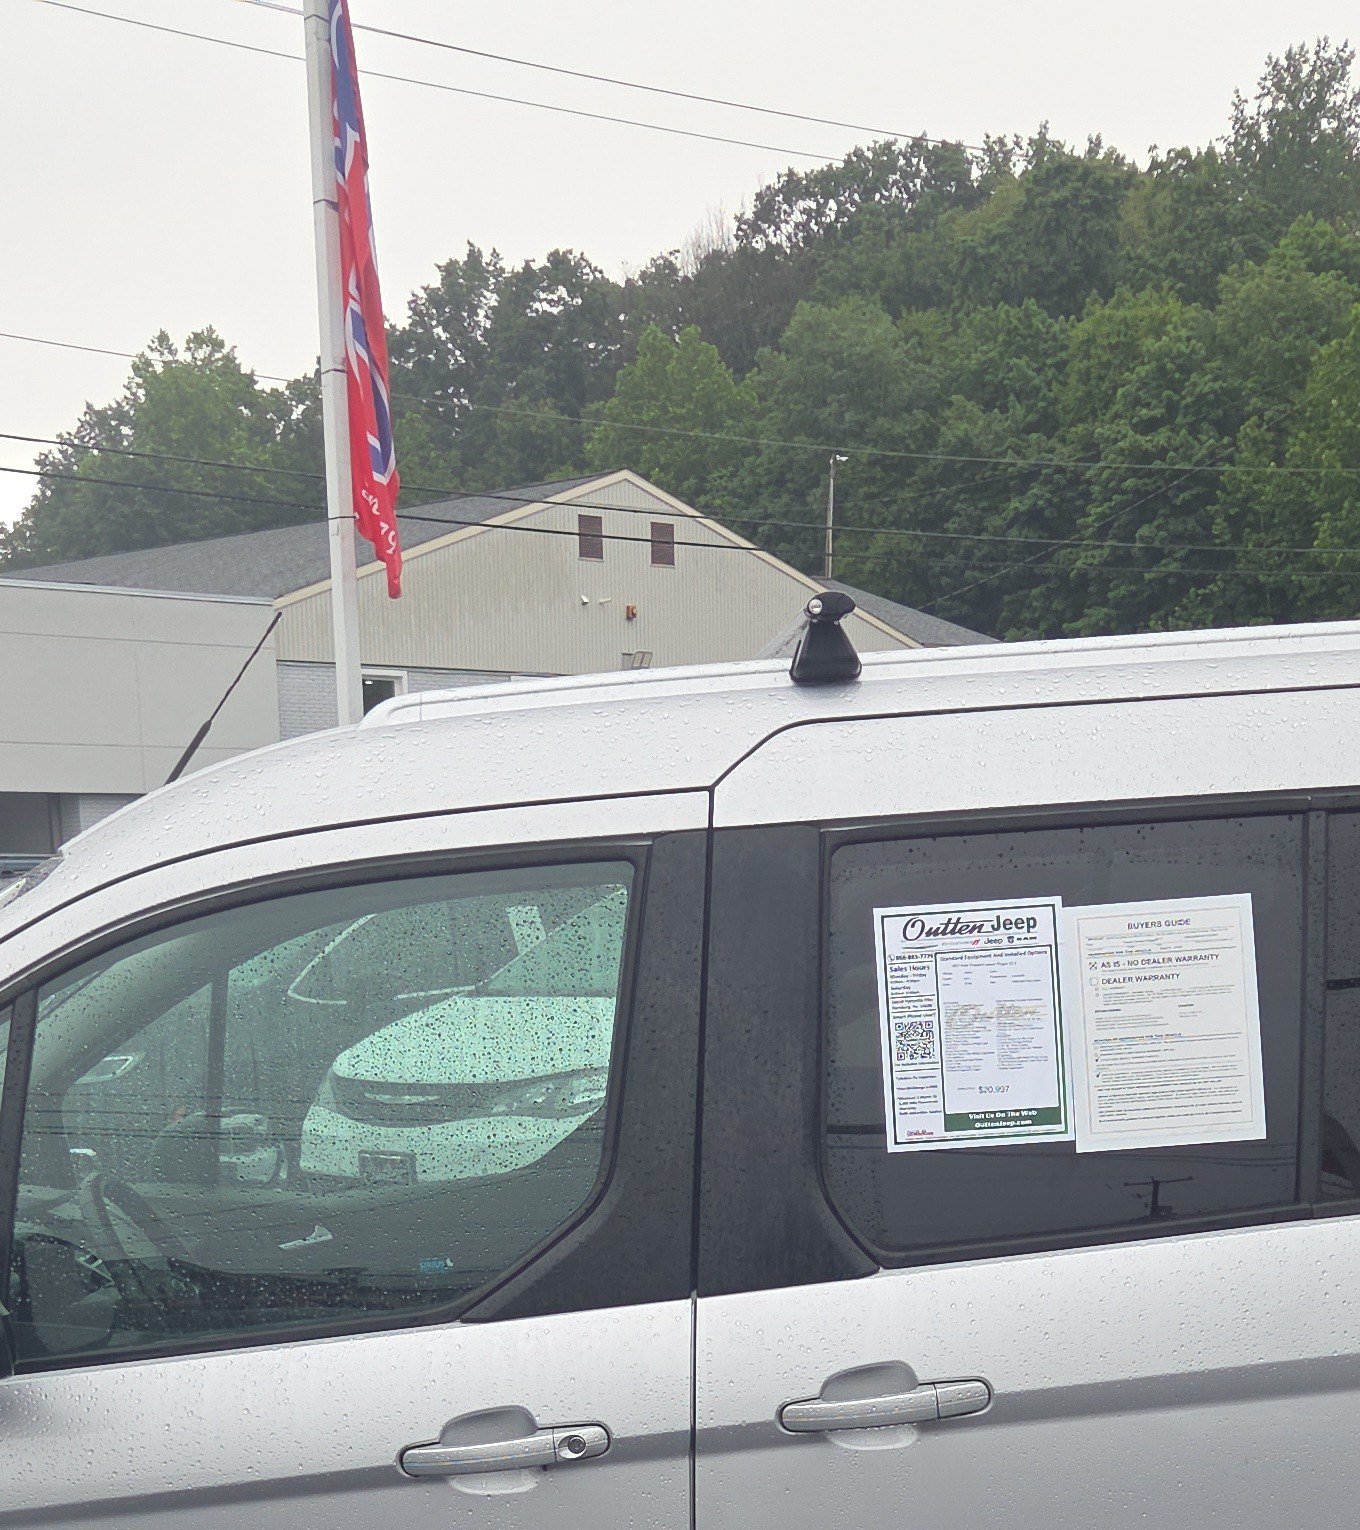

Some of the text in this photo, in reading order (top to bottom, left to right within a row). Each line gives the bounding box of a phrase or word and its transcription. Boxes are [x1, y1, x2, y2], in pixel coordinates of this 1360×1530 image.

[902, 914, 1037, 941] Outten Jeep
[1127, 920, 1161, 930] BUYERS
[1100, 961, 1111, 969] AS
[1127, 959, 1139, 967] NO
[1141, 957, 1172, 966] DEALER
[1175, 953, 1219, 963] WARRANTY
[1101, 973, 1181, 985] DEALER WARRANTY
